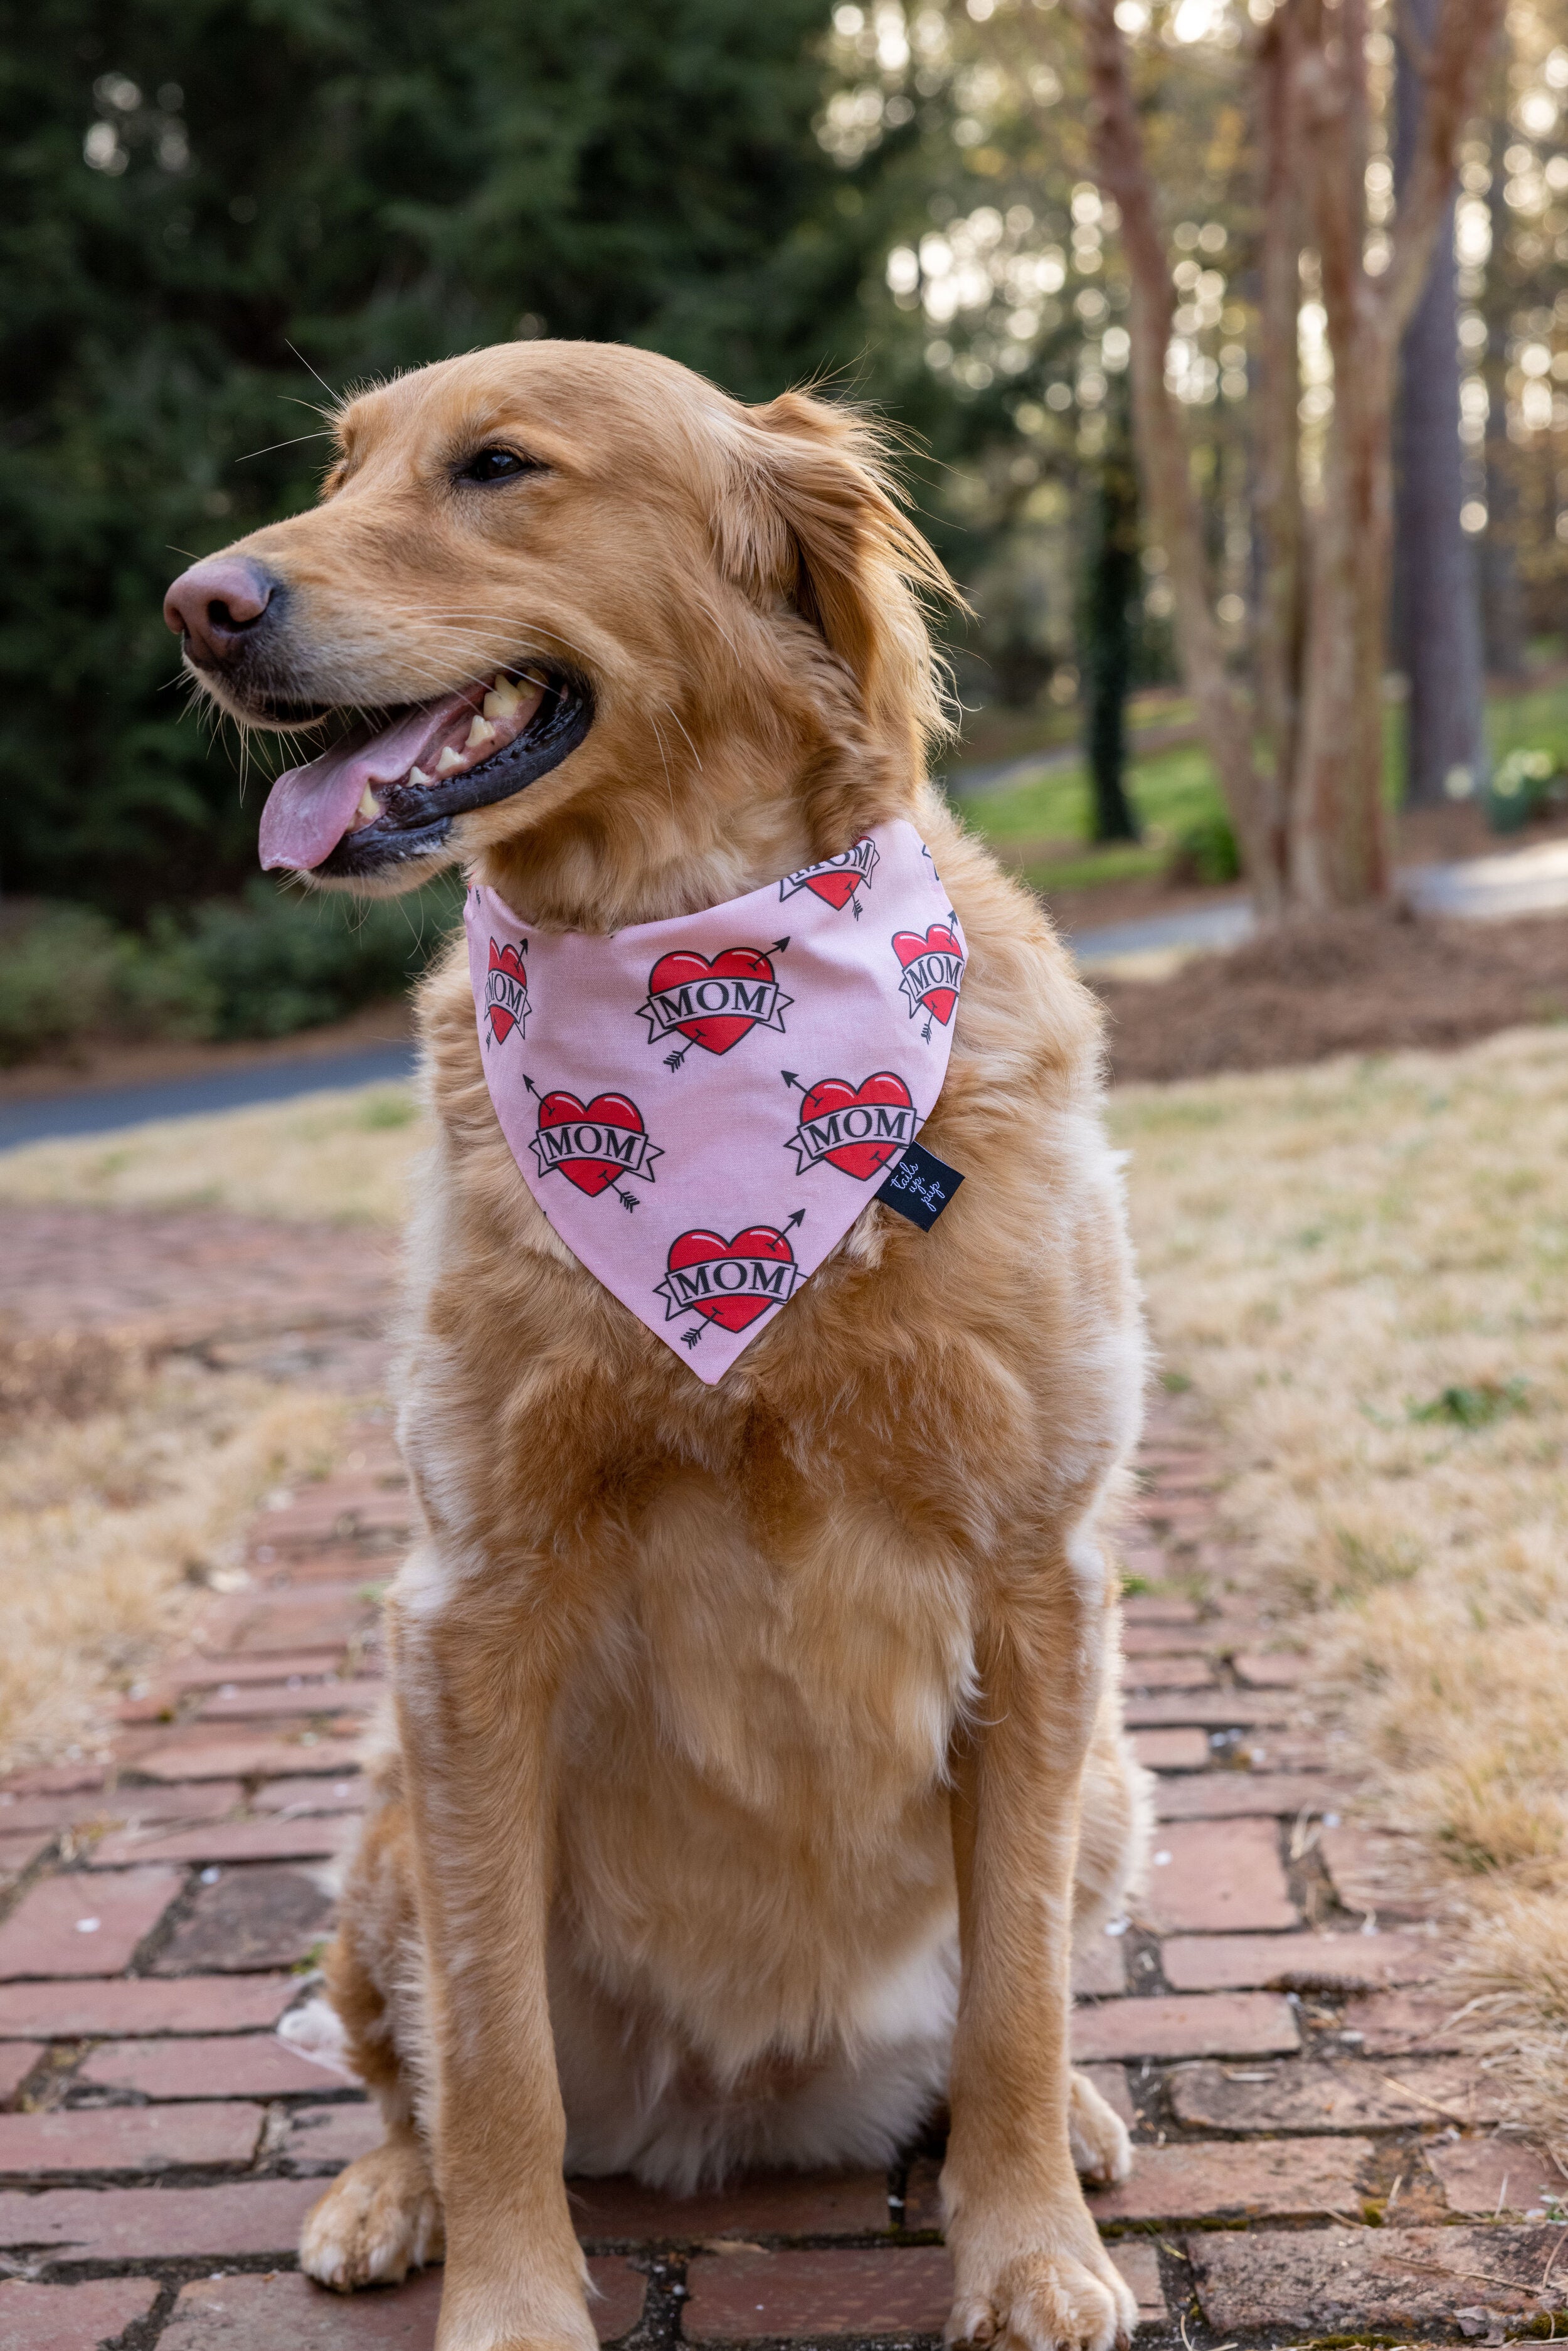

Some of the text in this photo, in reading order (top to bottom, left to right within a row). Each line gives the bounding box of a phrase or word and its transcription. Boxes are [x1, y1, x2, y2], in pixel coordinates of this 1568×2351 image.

[488, 972, 524, 1017] MOM
[906, 955, 963, 997] MOM
[654, 981, 771, 1023] MOM
[541, 1125, 641, 1164] MOM
[803, 1108, 911, 1153] MOM
[890, 1162, 918, 1189] tails
[921, 1181, 945, 1212] pup
[671, 1261, 791, 1301] MOM
